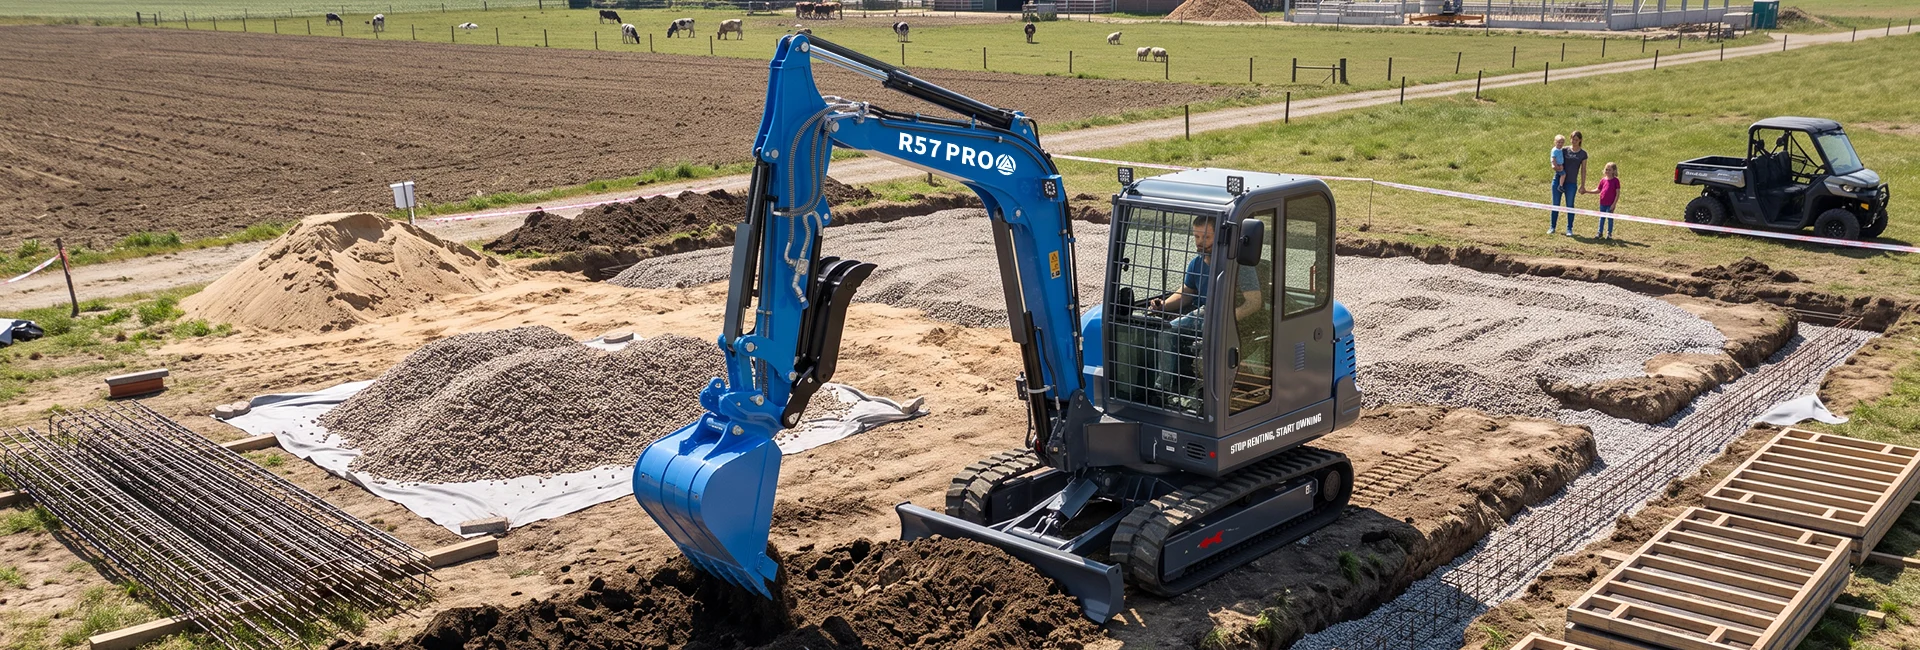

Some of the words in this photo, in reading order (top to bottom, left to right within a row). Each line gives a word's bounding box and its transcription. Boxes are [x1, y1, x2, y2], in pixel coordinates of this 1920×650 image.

[898, 131, 942, 158] R57
[945, 142, 994, 170] PRO
[1230, 440, 1247, 455] STOP
[1247, 430, 1275, 448] RENTING,
[1276, 422, 1295, 438] START
[1295, 412, 1322, 431] OWNING
